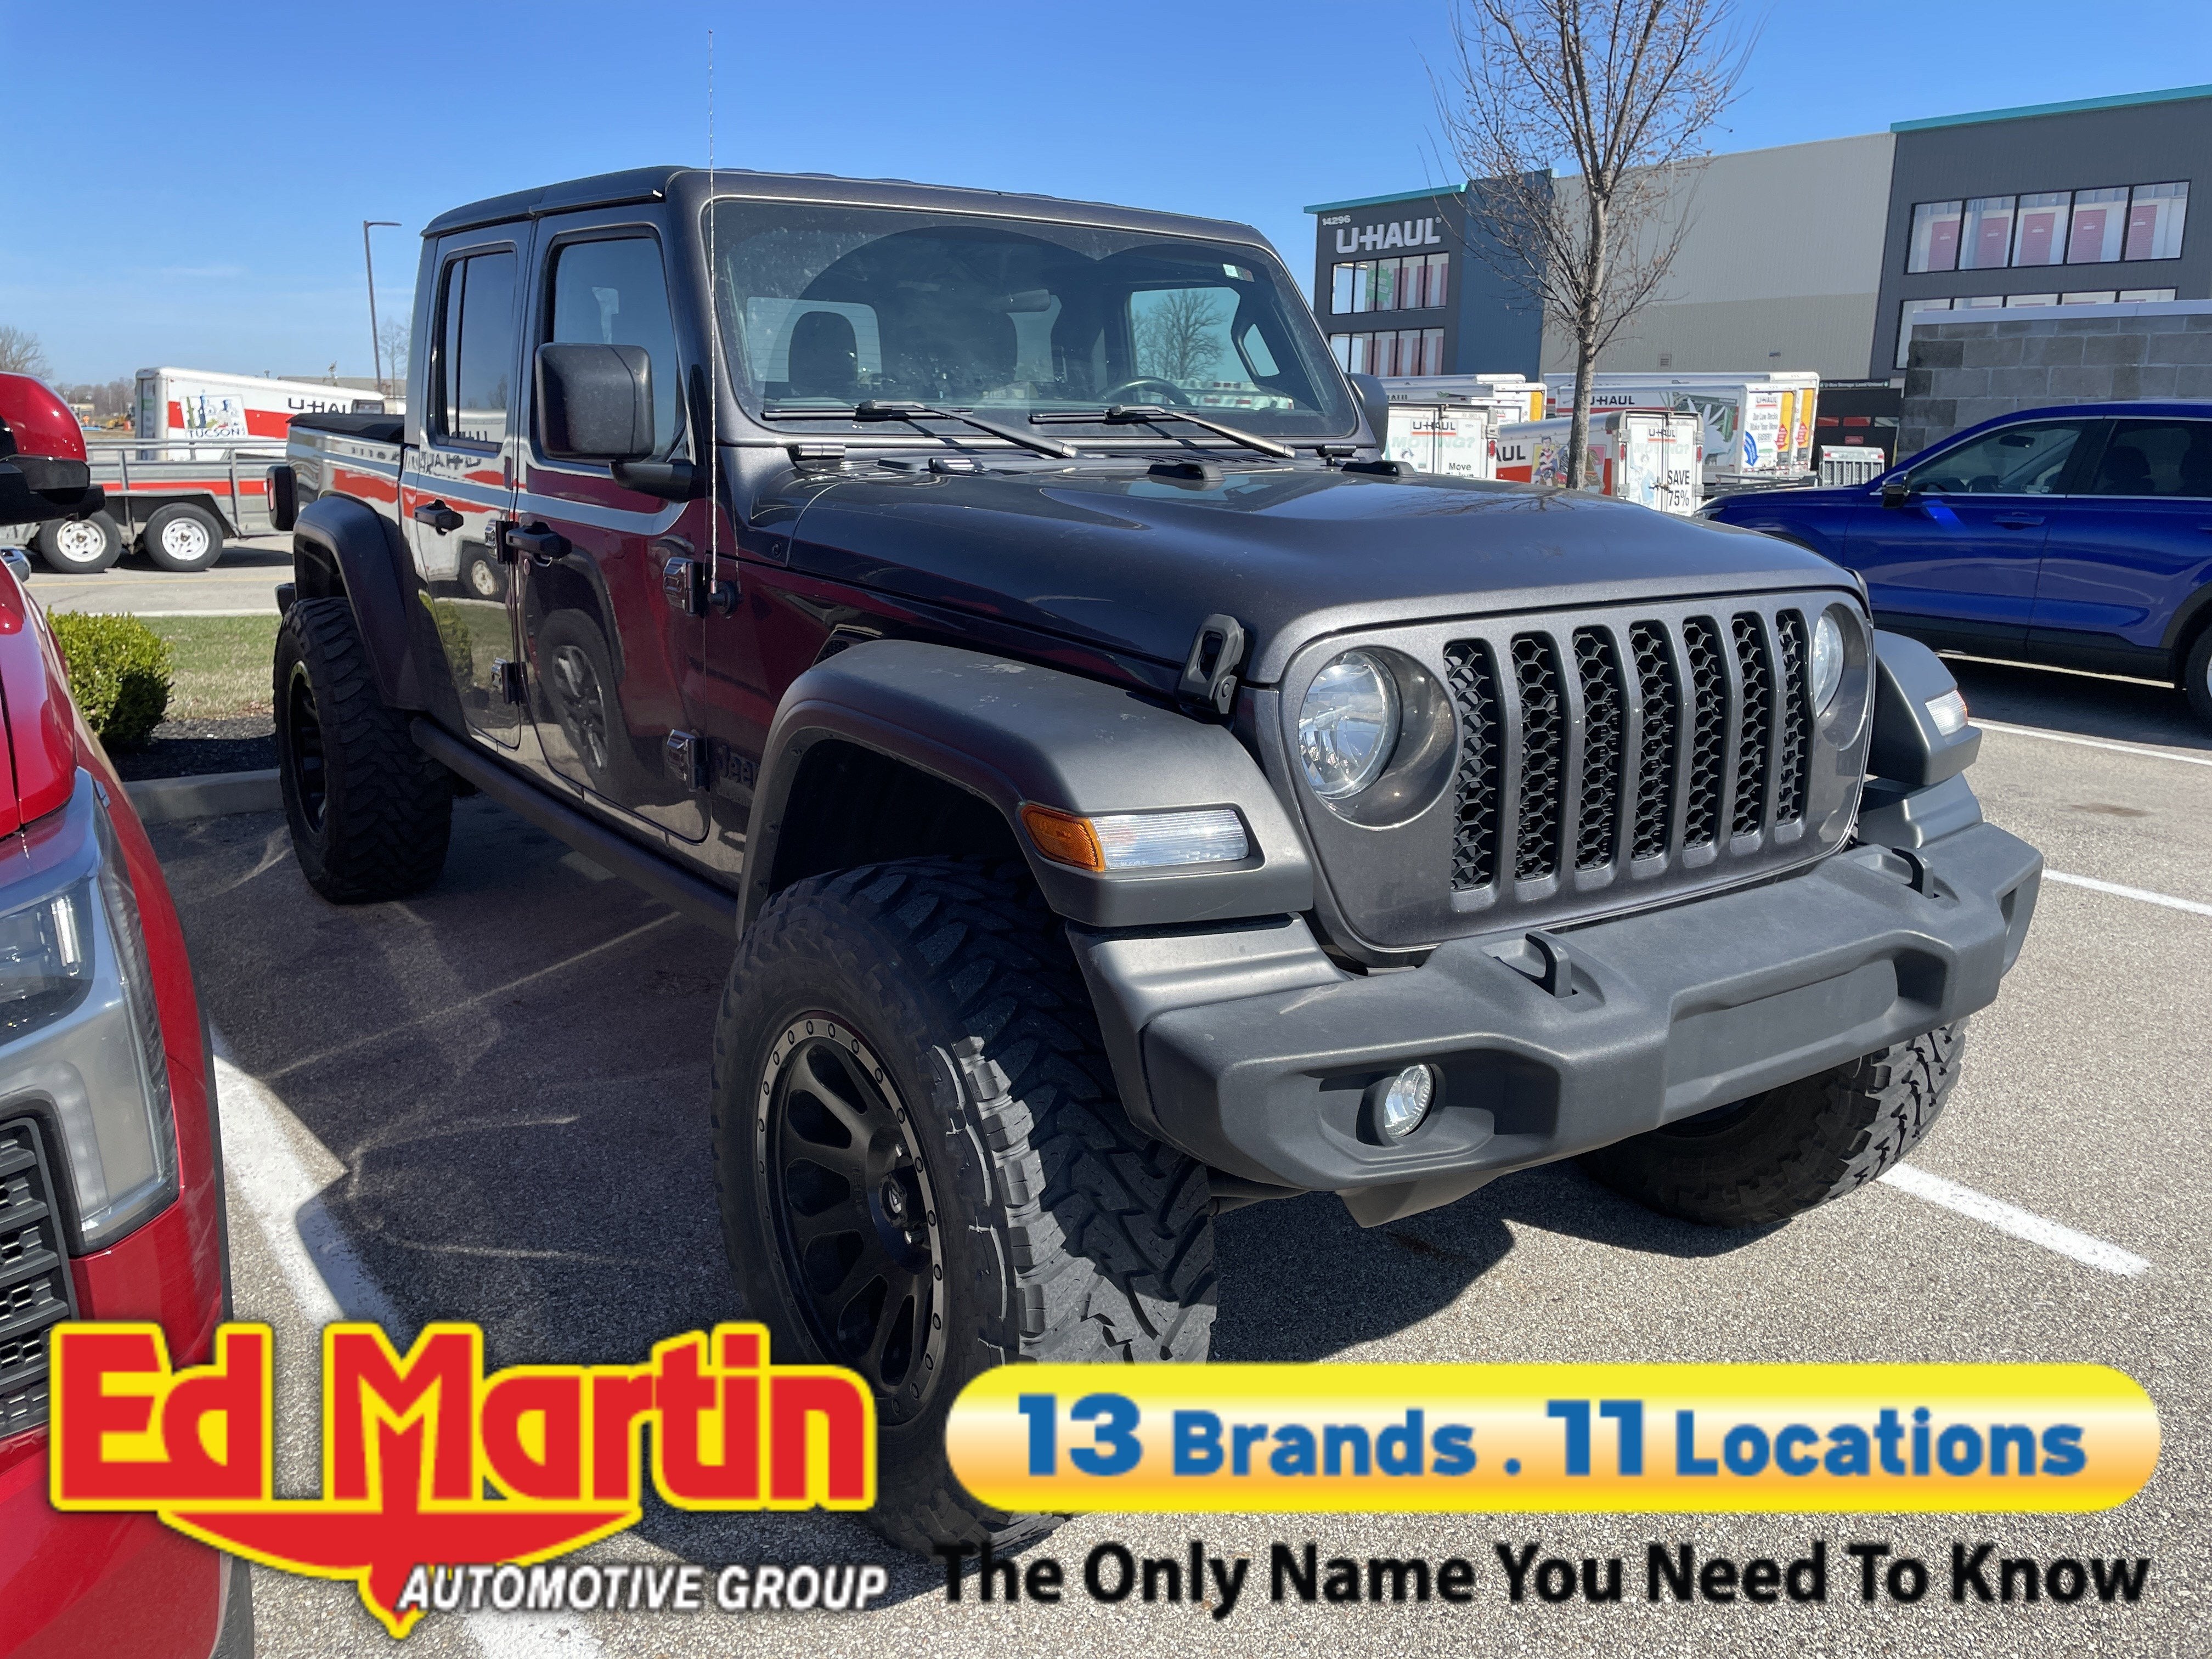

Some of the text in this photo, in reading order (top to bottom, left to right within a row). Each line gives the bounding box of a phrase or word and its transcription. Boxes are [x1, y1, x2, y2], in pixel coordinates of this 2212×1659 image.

[1322, 215, 1351, 225] 14296
[1336, 218, 1441, 253] U-HAUL
[1449, 462, 1471, 471] Move
[1668, 470, 1690, 485] SAVE
[1668, 490, 1690, 506] 75%
